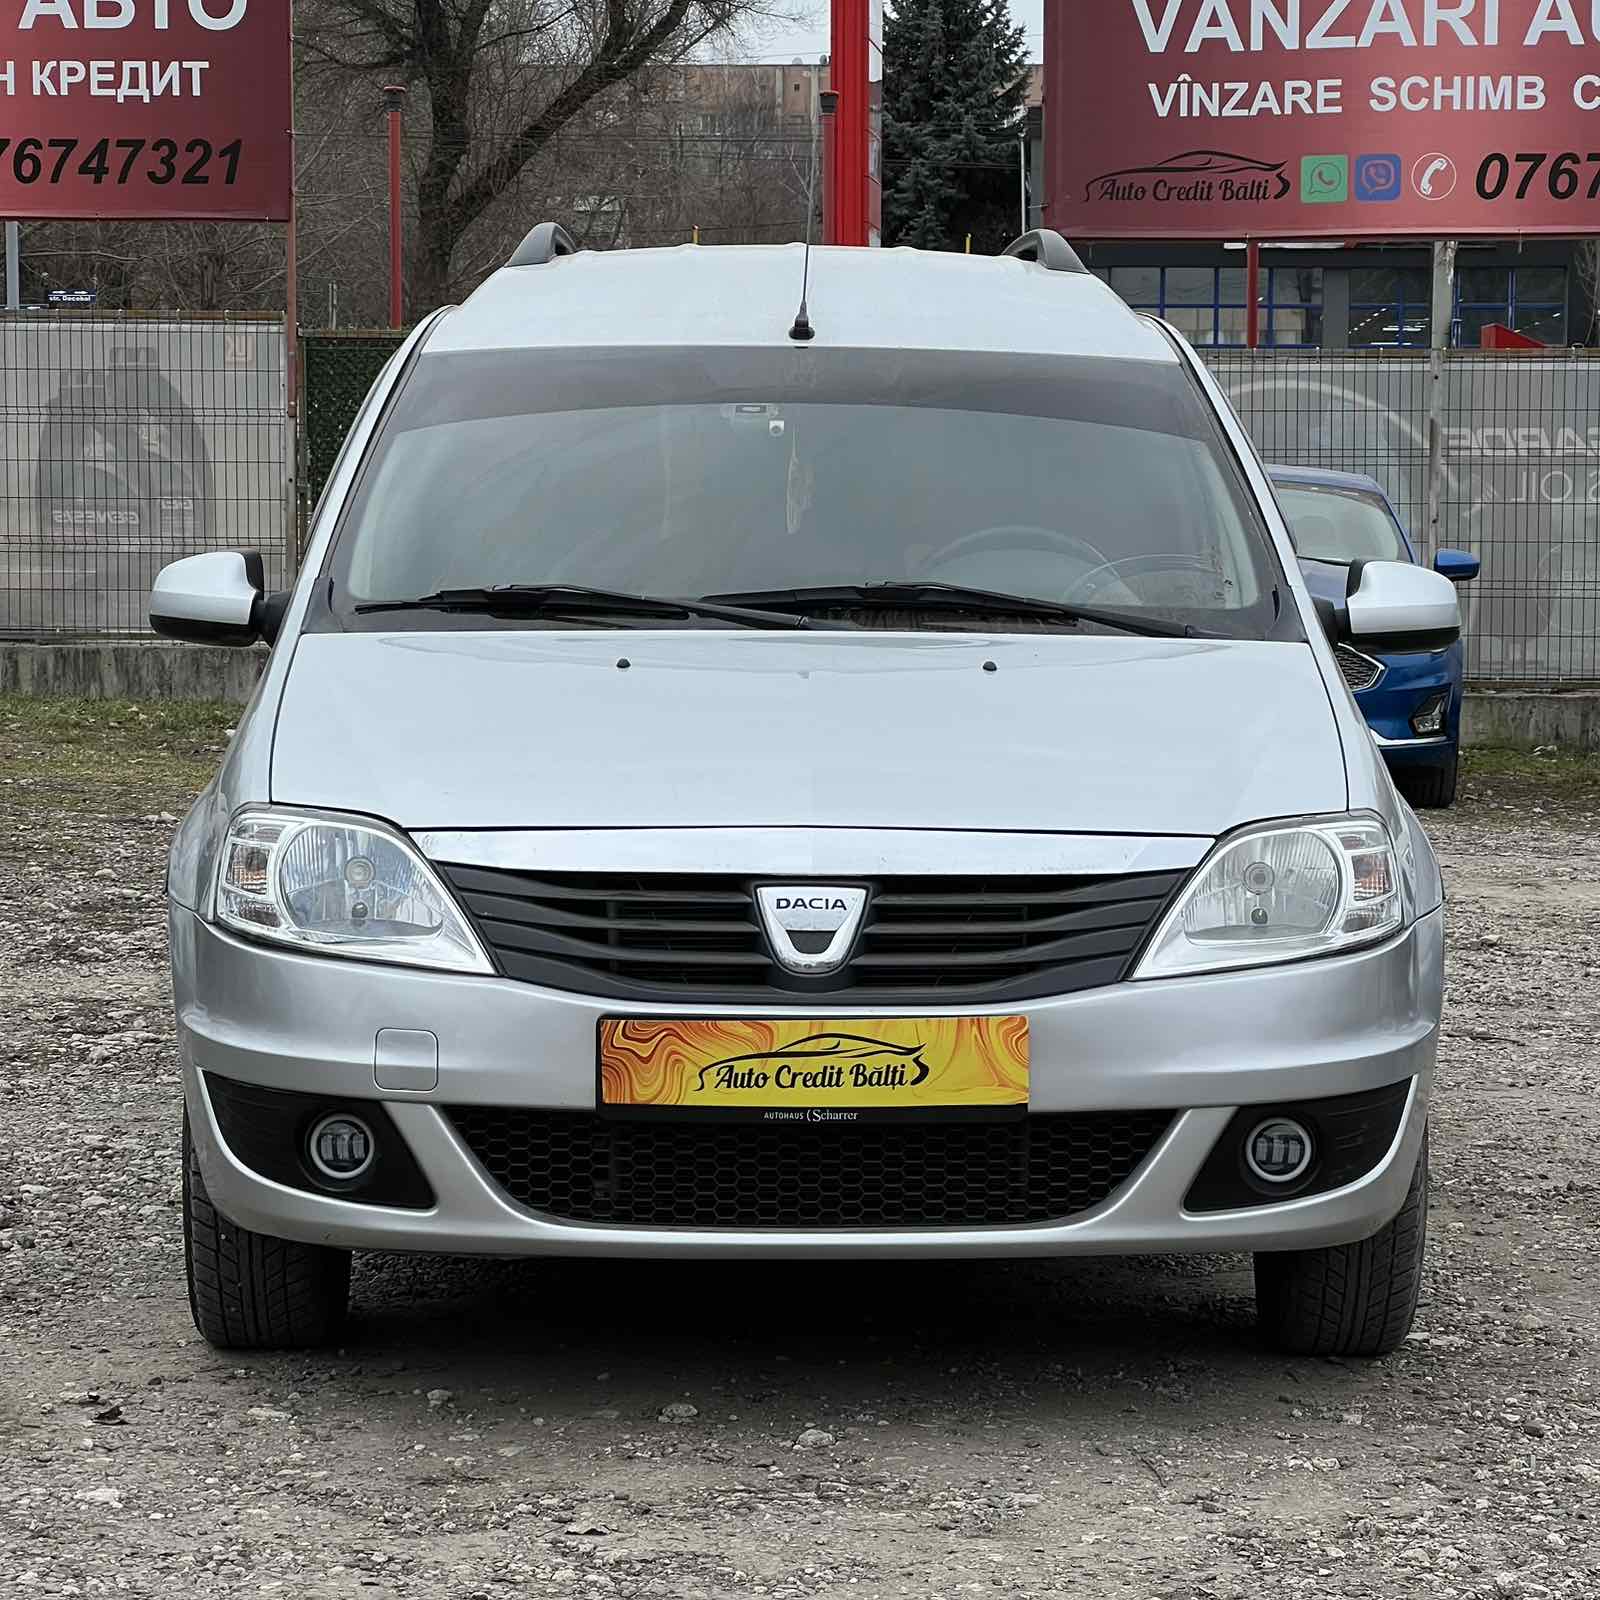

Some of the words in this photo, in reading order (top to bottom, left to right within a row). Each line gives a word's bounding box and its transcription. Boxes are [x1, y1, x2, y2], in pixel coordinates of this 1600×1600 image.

[1522, 0, 1600, 47] A
[32, 60, 210, 104] КРЕДИТ
[1148, 73, 1343, 117] VÎNZARE
[1369, 75, 1546, 112] SCHIMB
[0, 137, 243, 186] 6747321
[1099, 178, 1147, 202] Auto
[1152, 178, 1215, 202] Credit
[776, 897, 847, 911] DACIA
[714, 1063, 770, 1089] Auto
[774, 1064, 845, 1089] Credit
[763, 1110, 804, 1121] AUTOHAUS
